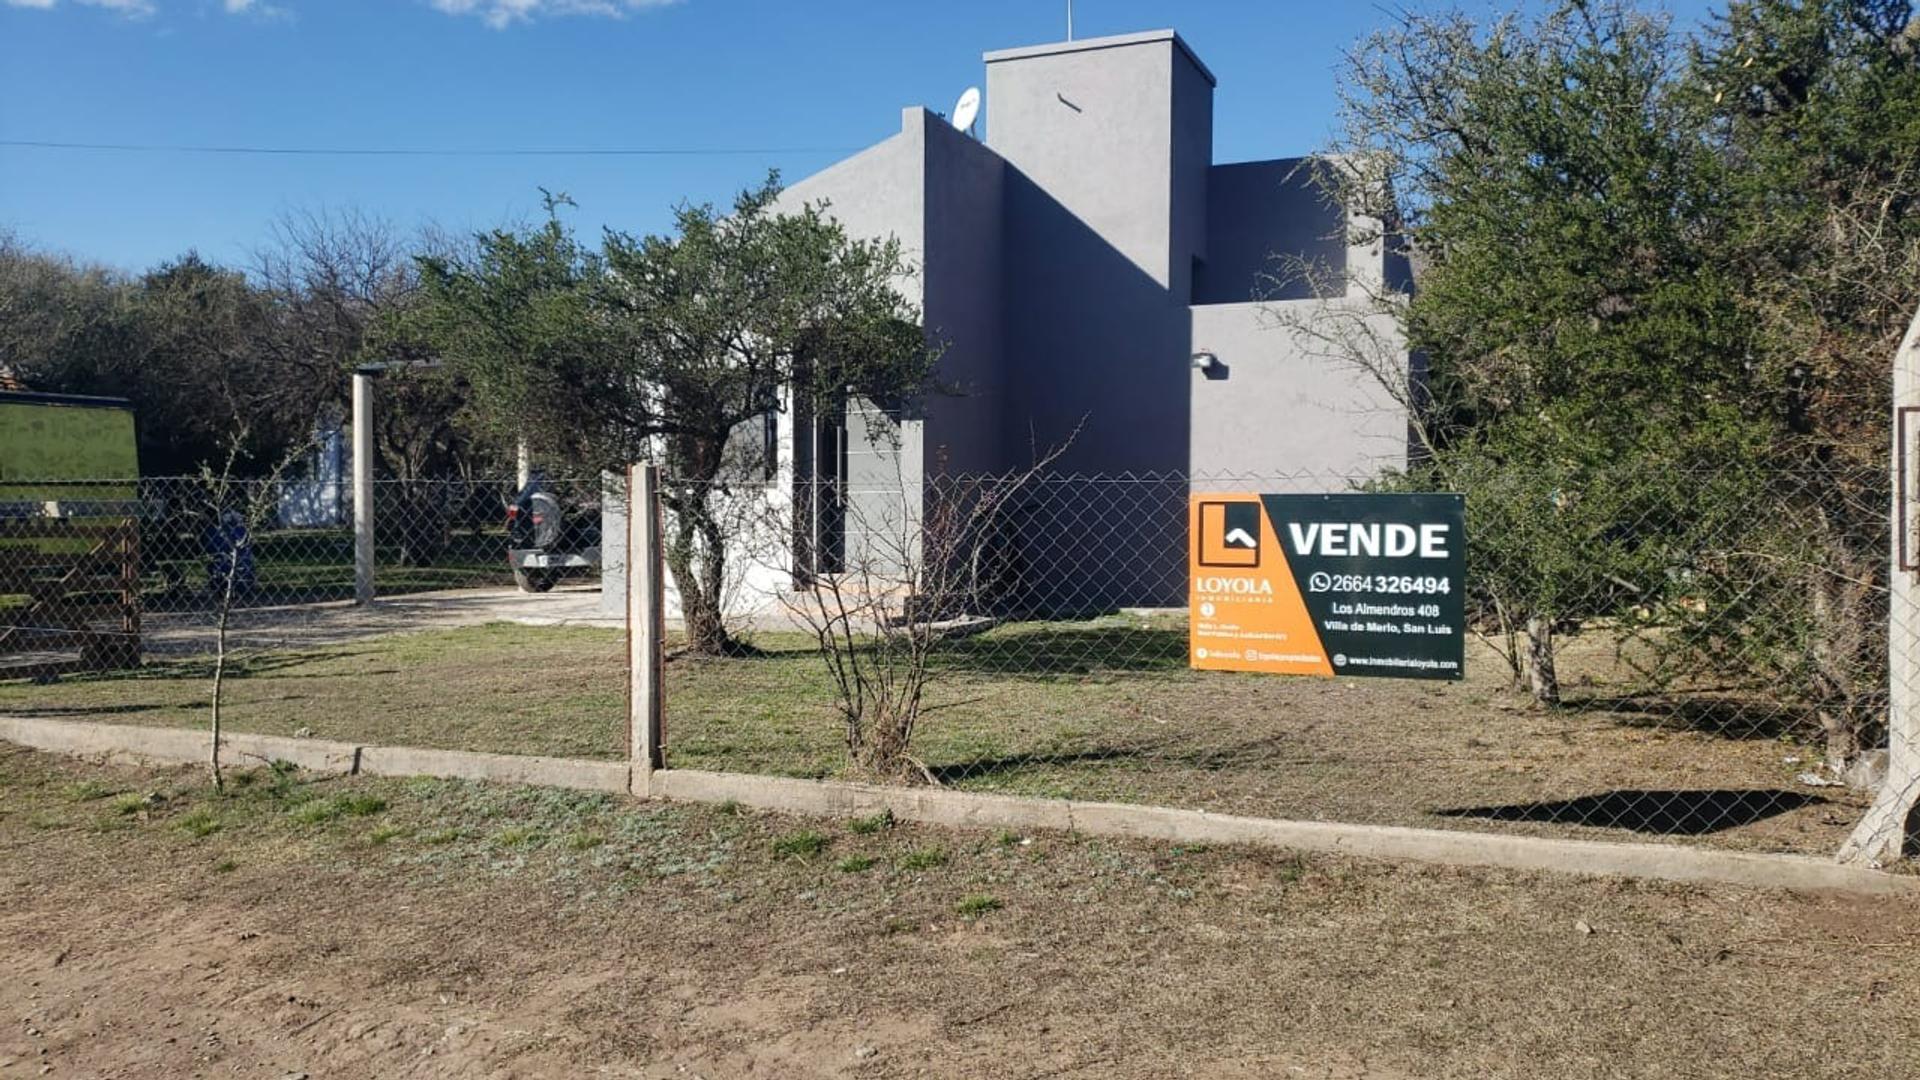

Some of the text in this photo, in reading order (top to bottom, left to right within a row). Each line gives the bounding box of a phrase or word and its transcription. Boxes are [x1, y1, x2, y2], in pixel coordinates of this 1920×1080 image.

[1288, 522, 1450, 558] VENDE
[1196, 577, 1273, 594] LOYOLA
[1332, 574, 1451, 595] 2664 326494
[1332, 602, 1440, 617] Los Almendros 408
[1324, 620, 1452, 635] Villa de Merlo, San Luis
